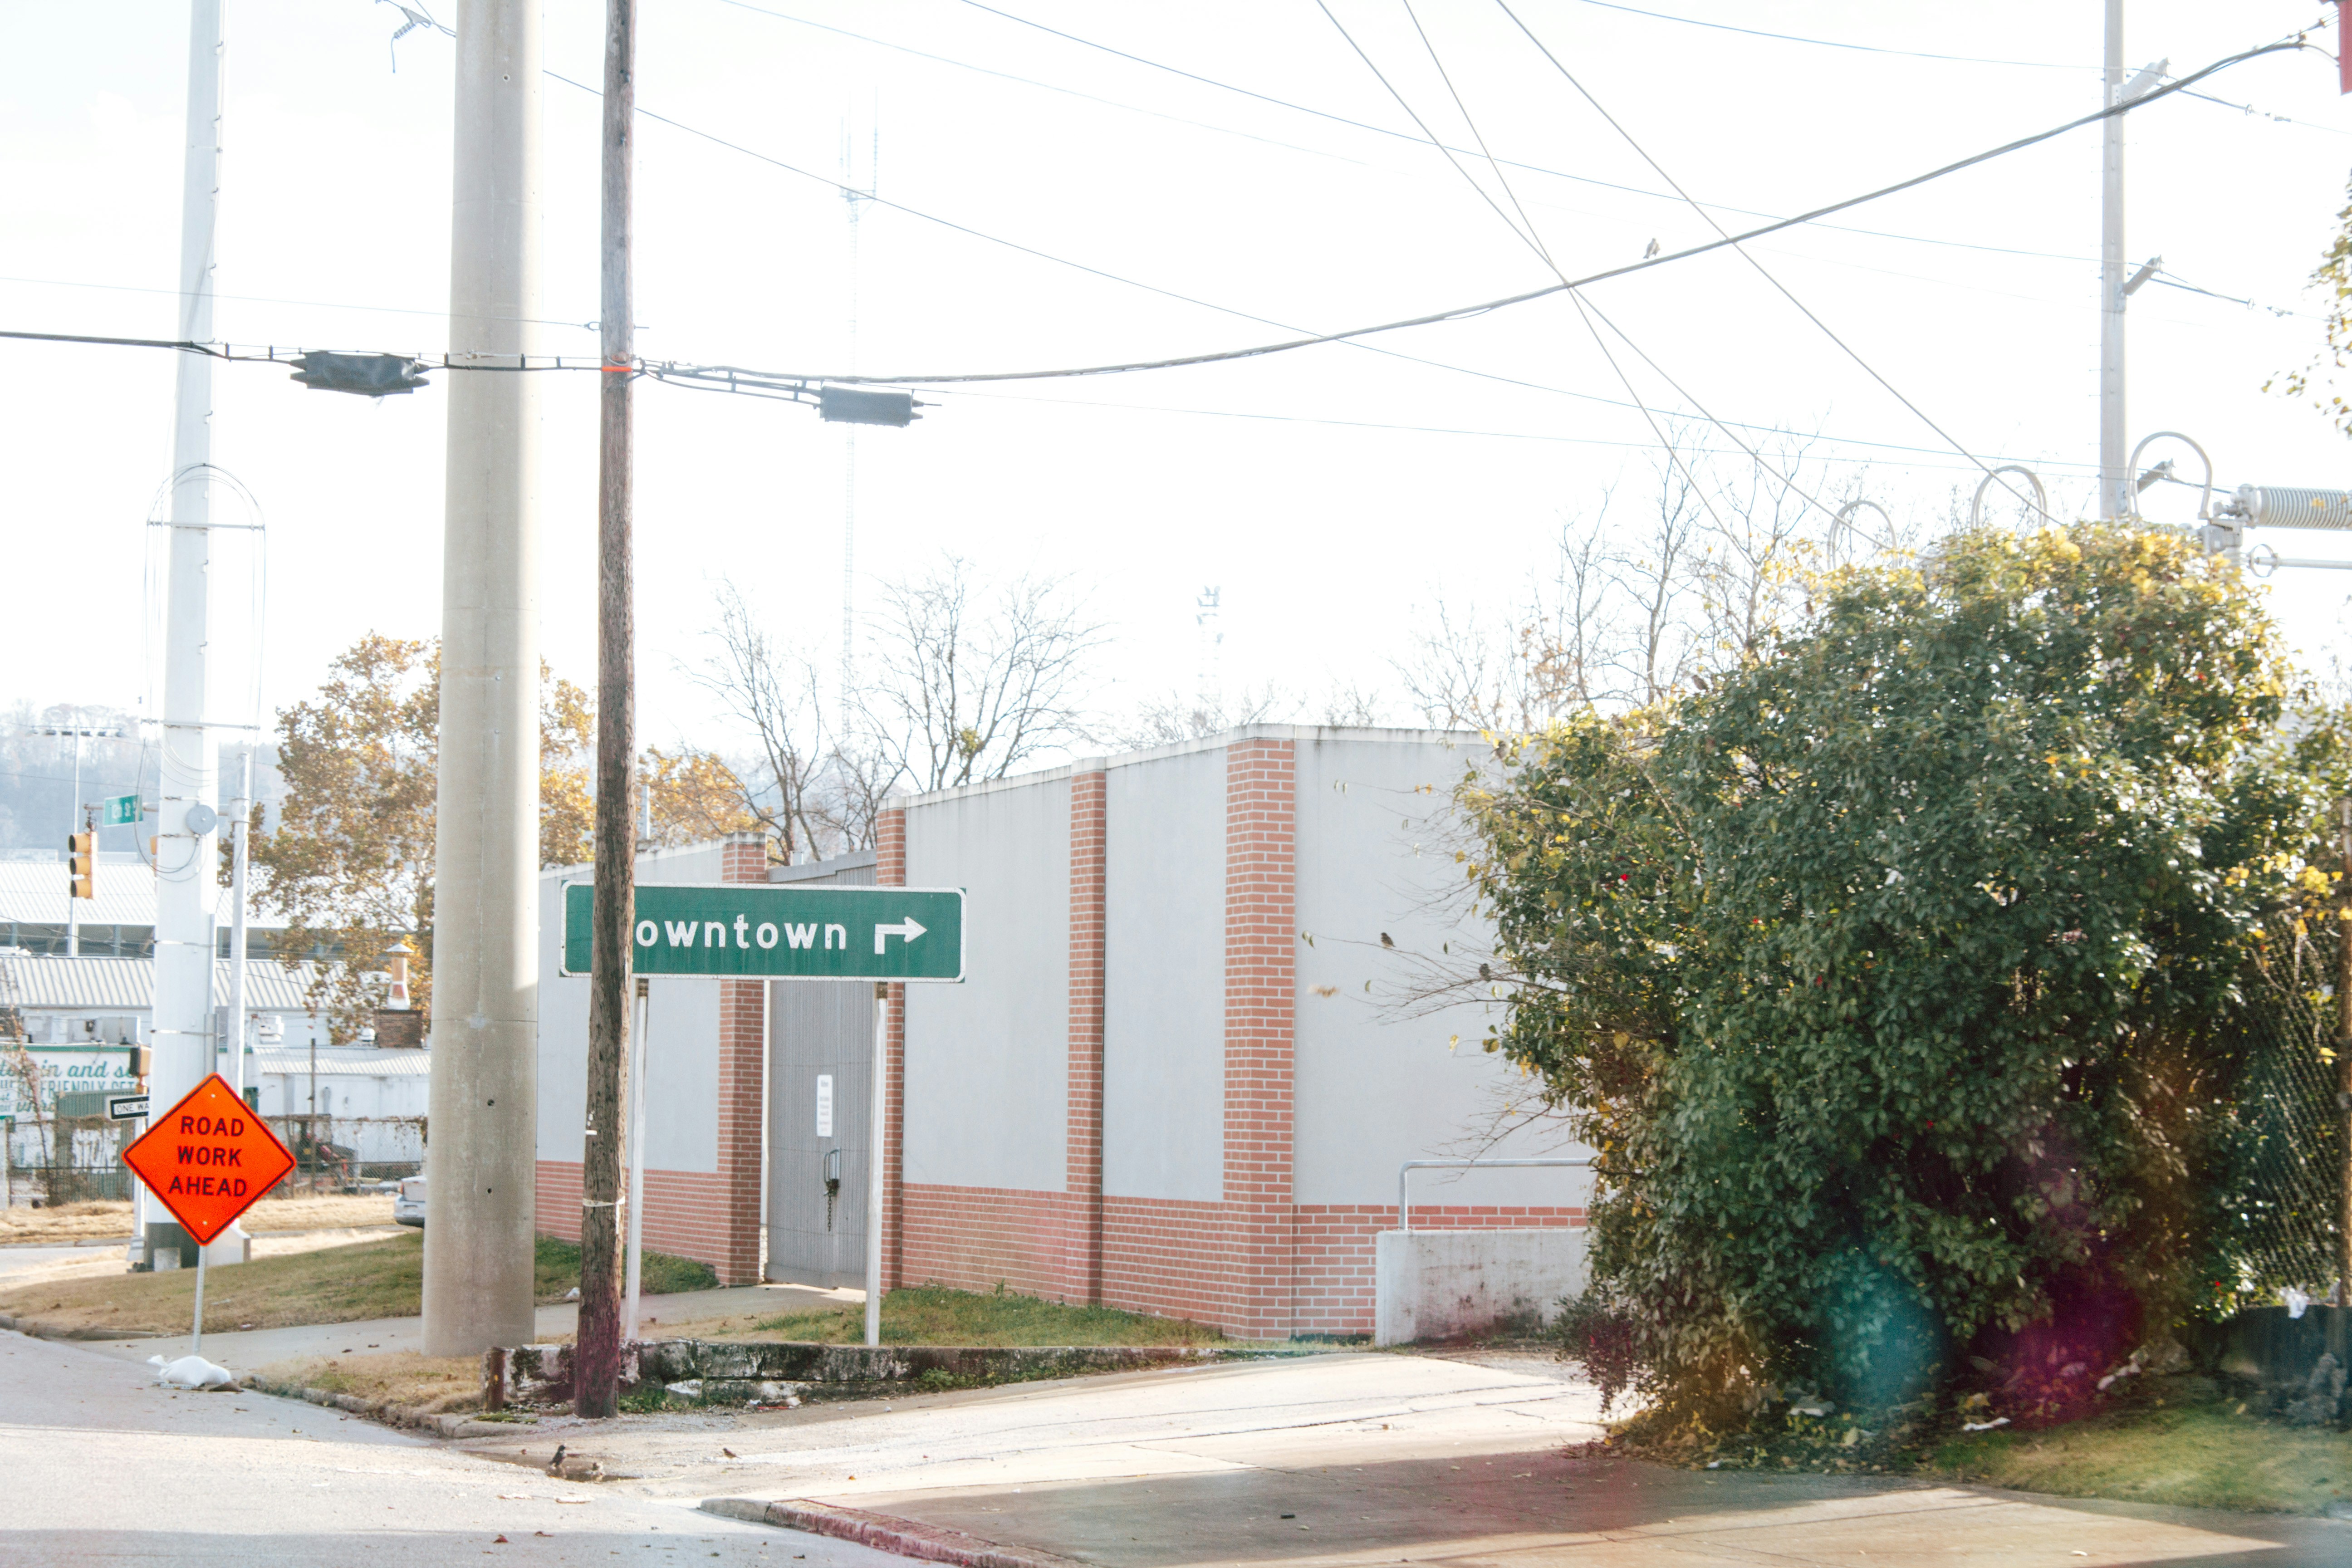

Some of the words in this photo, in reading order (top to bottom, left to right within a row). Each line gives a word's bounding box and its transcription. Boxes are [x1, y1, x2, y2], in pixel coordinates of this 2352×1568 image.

[636, 914, 847, 950] owntown
[67, 1060, 108, 1078] and
[117, 1104, 133, 1113] ONE
[181, 1116, 244, 1137] ROAD
[177, 1146, 242, 1167] WORK
[168, 1176, 247, 1197] AHEAD
